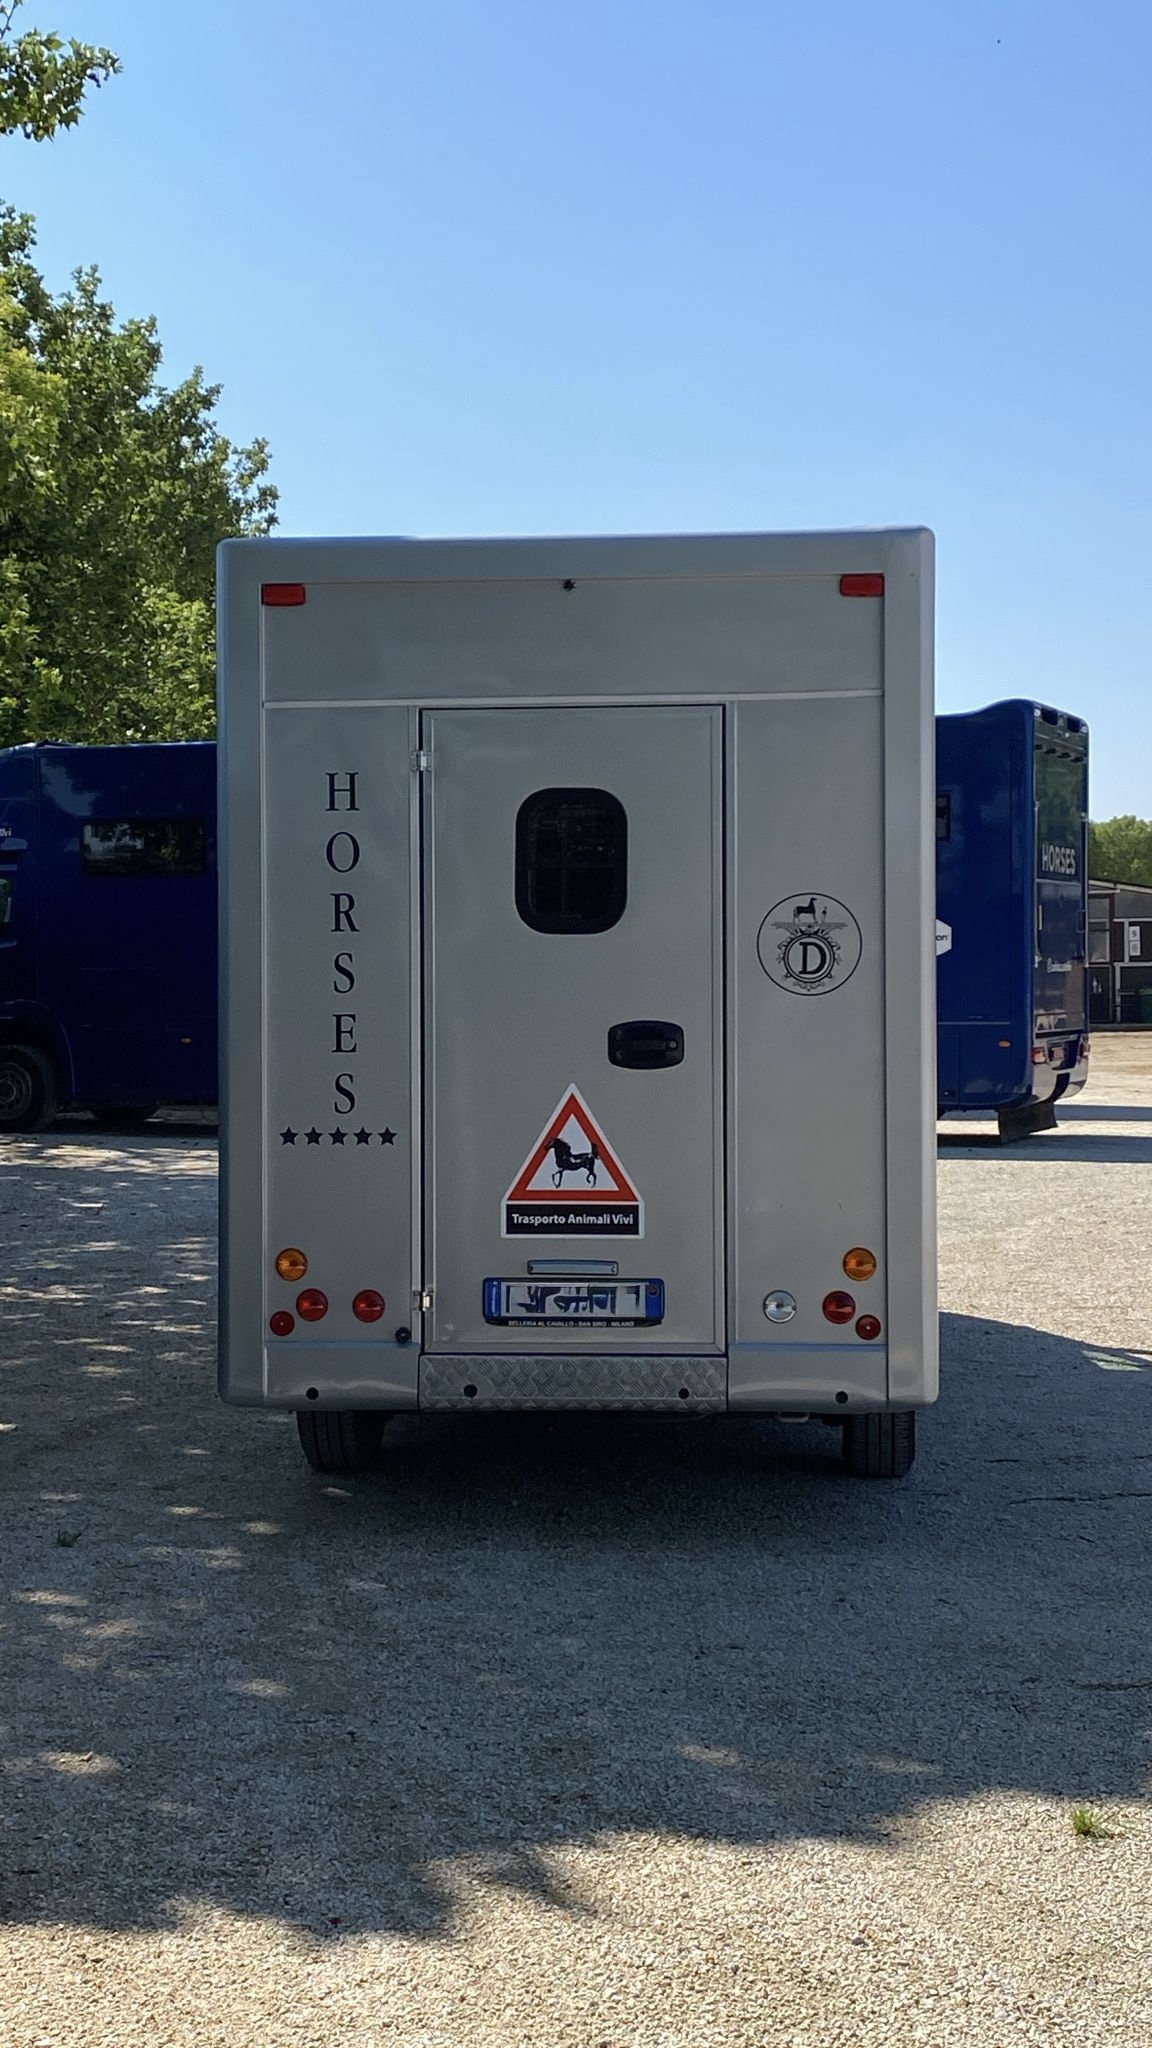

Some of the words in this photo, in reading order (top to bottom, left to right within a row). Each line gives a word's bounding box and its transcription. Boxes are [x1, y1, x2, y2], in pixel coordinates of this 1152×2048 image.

[1042, 844, 1076, 875] HORSES
[324, 771, 362, 1115] HORSES
[798, 942, 827, 974] D
[511, 1213, 566, 1226] Trasporto
[567, 1213, 611, 1225] Animali
[611, 1213, 634, 1225] Vivi
